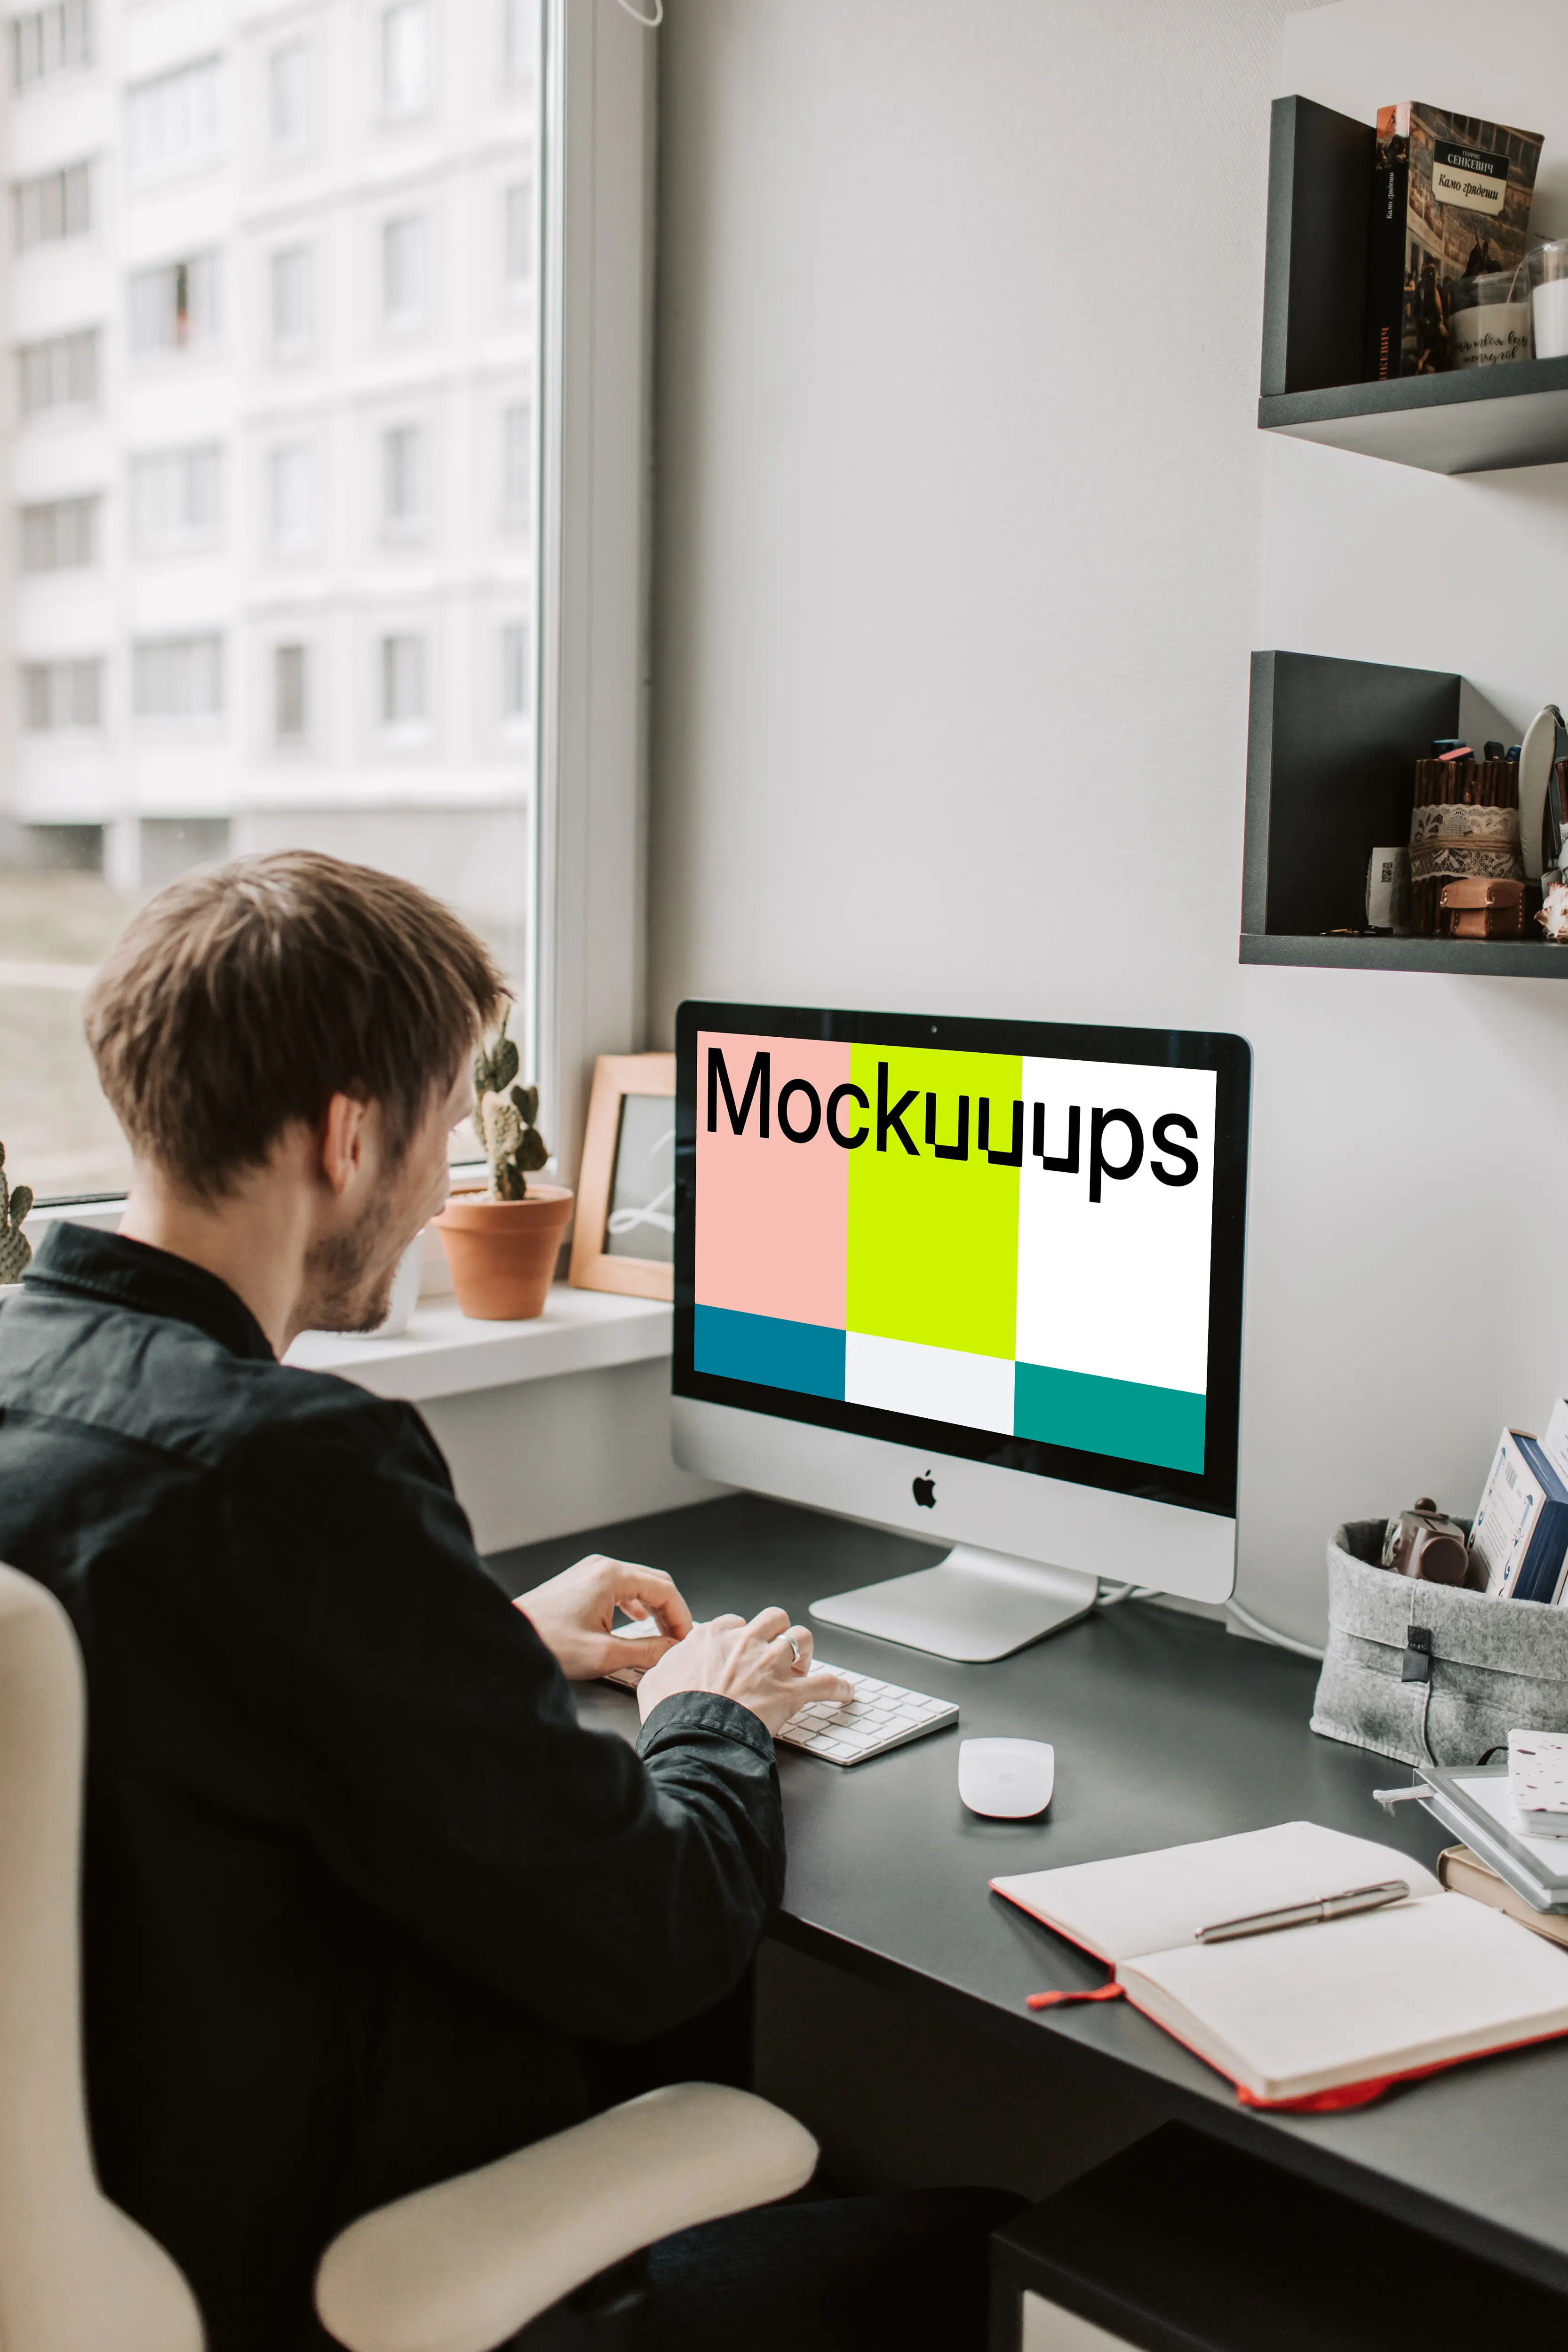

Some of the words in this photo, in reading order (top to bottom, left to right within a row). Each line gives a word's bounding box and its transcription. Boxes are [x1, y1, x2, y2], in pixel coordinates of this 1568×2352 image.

[1448, 153, 1494, 174] СЕНКЕВИЧ
[1463, 151, 1480, 159] ГЕНРИК
[1438, 174, 1461, 191] Камо
[1462, 183, 1499, 200] грядеши
[1379, 327, 1389, 381] НКЕВИЧ
[707, 1047, 1199, 1204] Mockuuups
